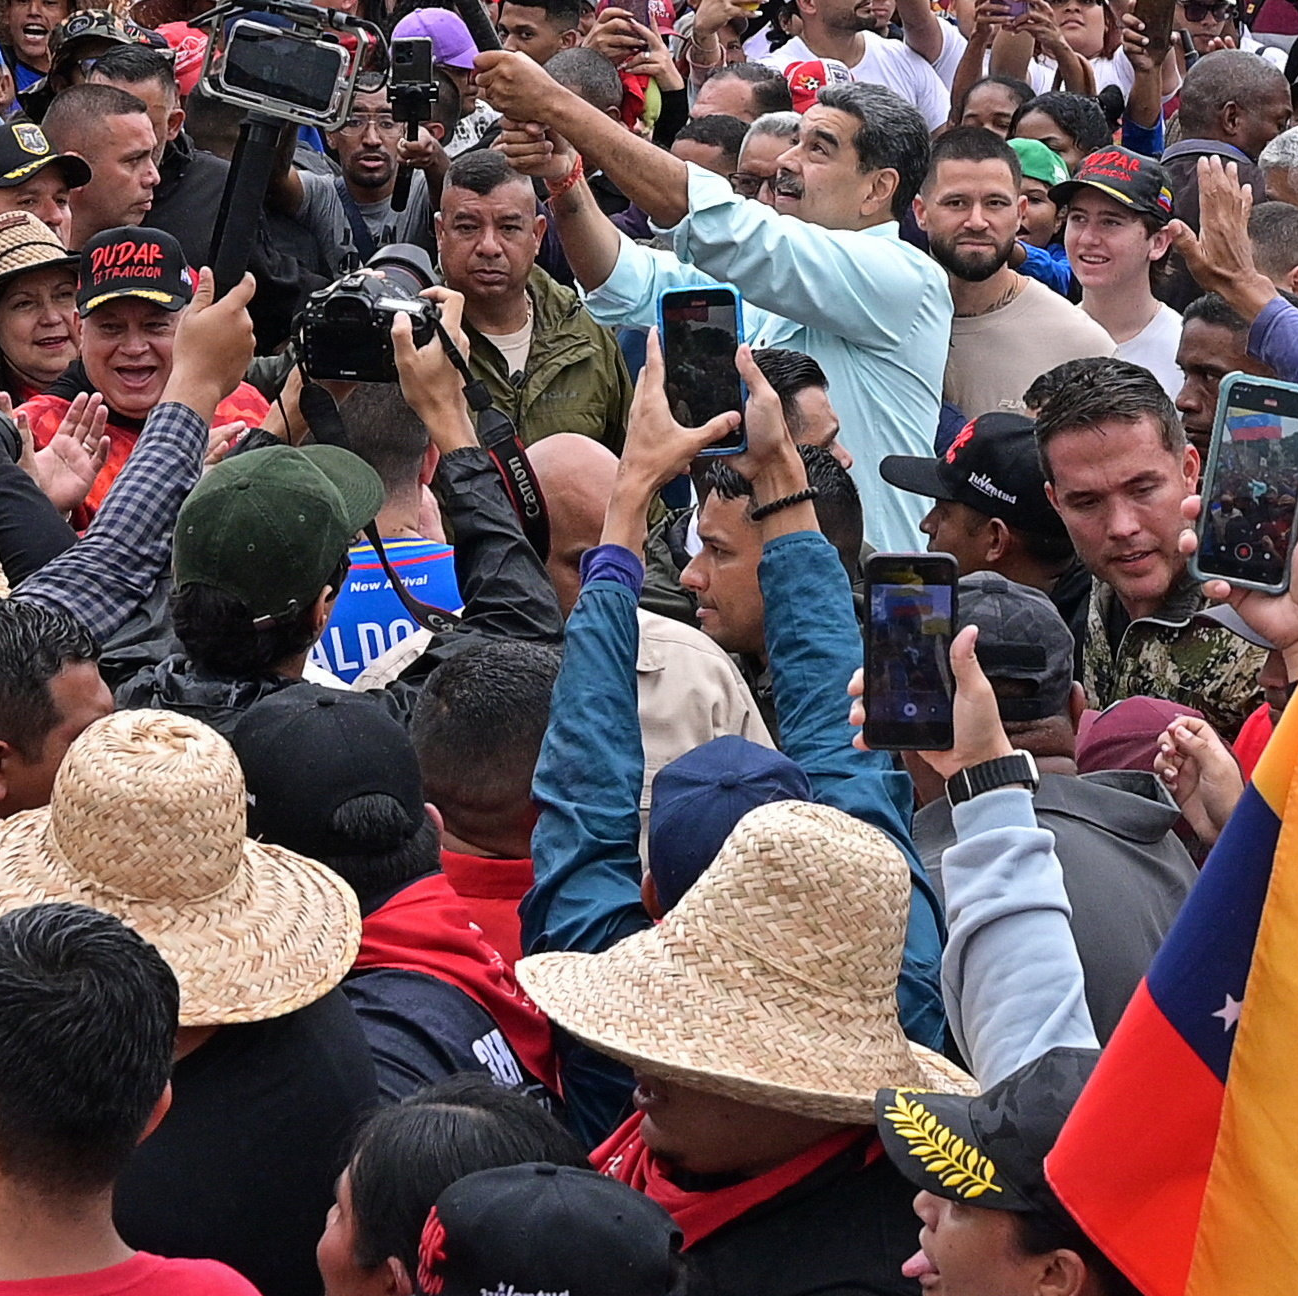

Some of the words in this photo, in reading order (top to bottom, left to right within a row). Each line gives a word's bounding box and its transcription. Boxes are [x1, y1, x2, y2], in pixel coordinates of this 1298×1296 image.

[90, 241, 164, 274] DUDAR
[104, 266, 161, 281] TRAICION
[507, 455, 540, 518] Canon
[350, 580, 381, 593] New
